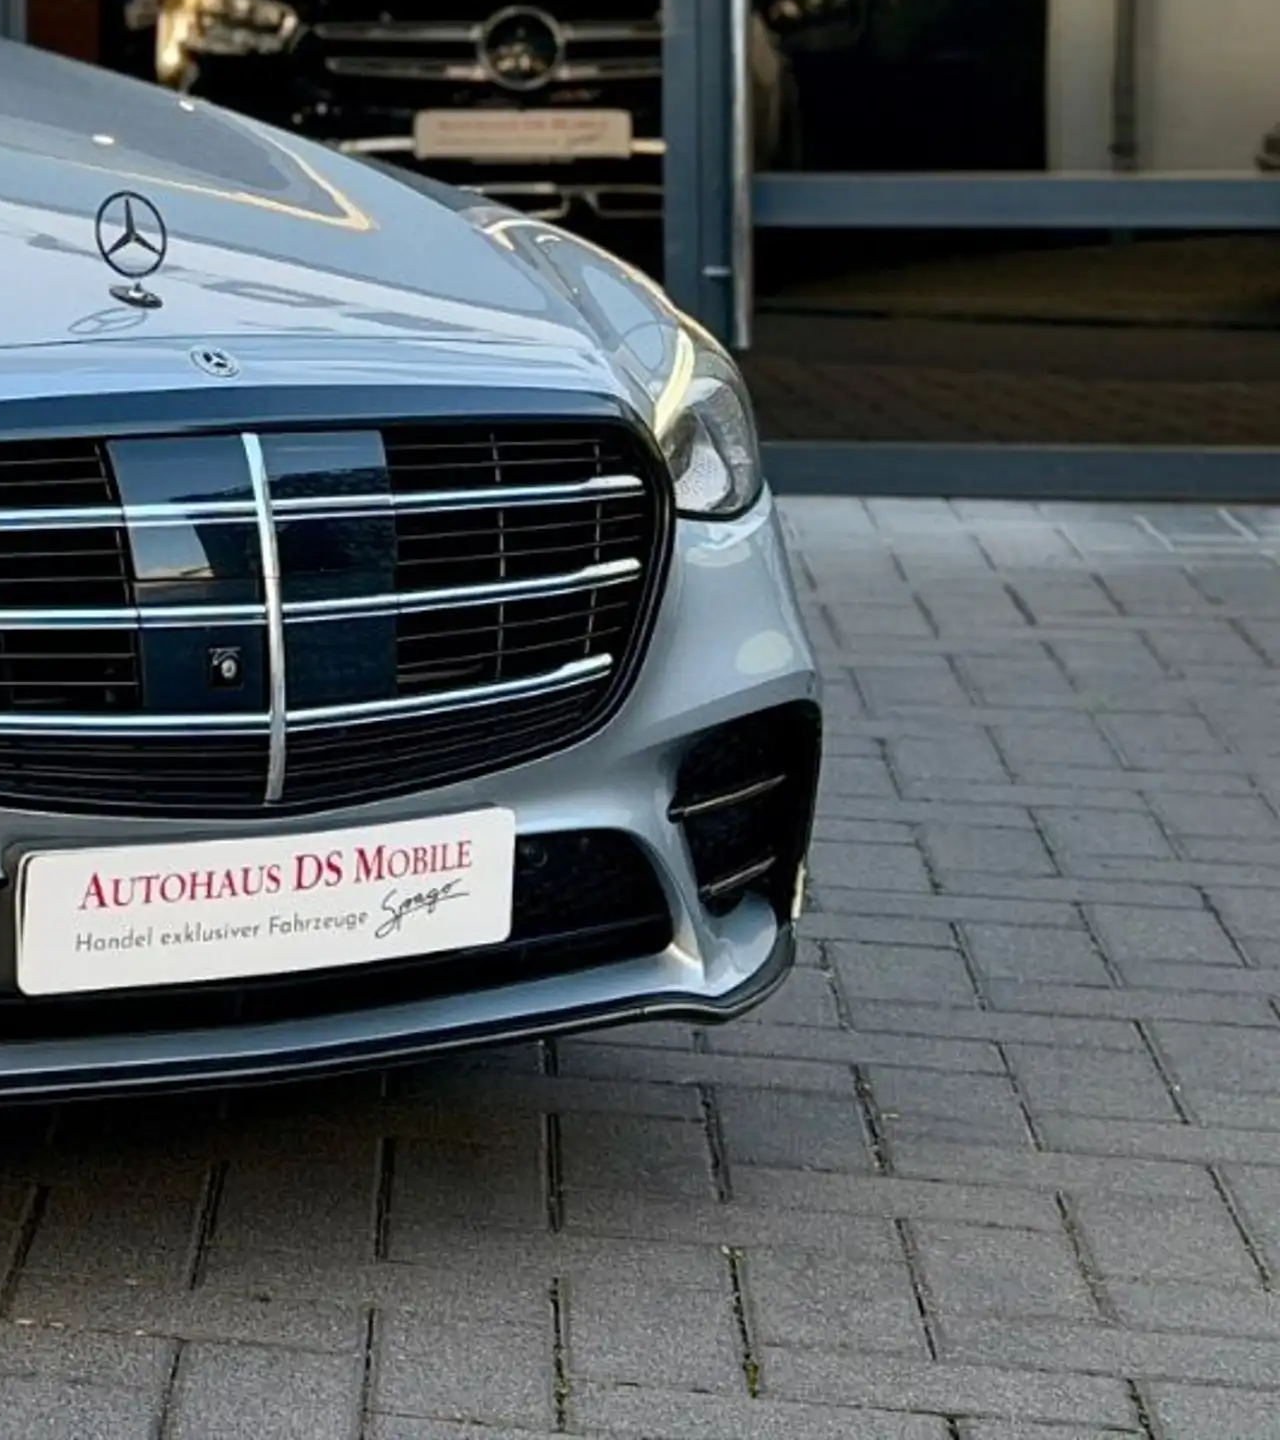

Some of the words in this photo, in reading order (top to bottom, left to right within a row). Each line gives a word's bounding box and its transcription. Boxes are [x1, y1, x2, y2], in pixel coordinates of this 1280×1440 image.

[77, 863, 282, 910] AUTOHAUS
[292, 850, 344, 892] DS
[354, 839, 473, 884] MOBILE
[74, 926, 154, 953] Handel
[159, 921, 261, 946] exklusiver
[268, 910, 370, 935] Fahrzeuge
